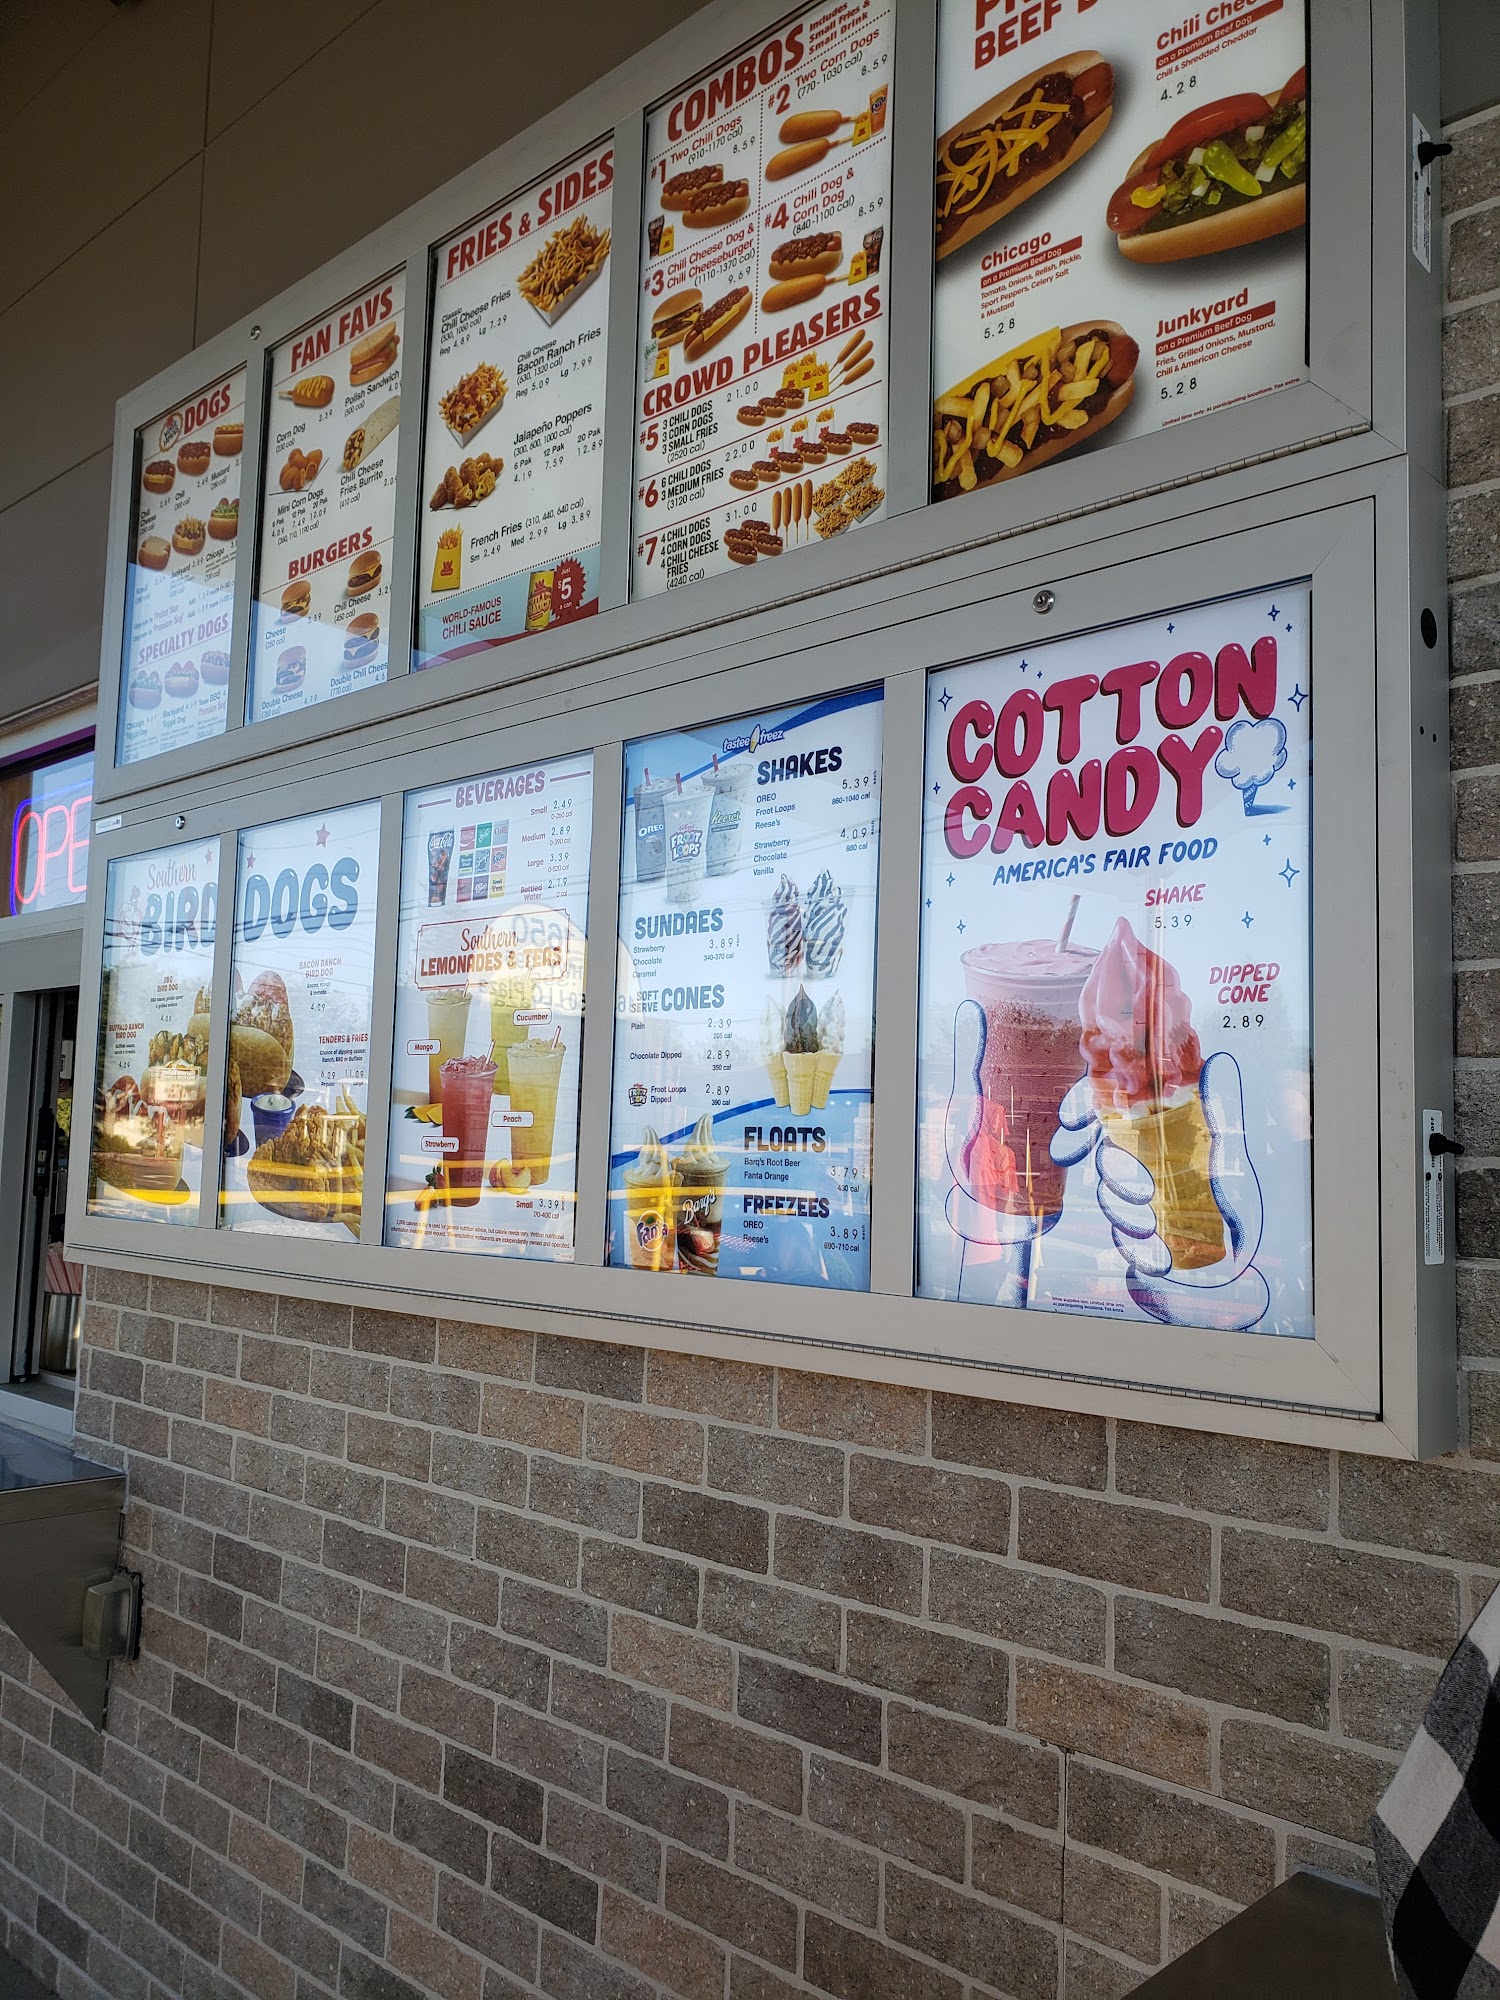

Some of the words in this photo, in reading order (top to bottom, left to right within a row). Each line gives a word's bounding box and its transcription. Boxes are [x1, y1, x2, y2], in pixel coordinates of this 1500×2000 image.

[808, 30, 837, 55] Small
[840, 11, 869, 35] Drink
[974, 2, 1062, 70] BEEF
[1156, 13, 1200, 50] Chili
[1156, 67, 1173, 81] Chili
[1174, 64, 1180, 73] &
[1181, 44, 1220, 70] Shredded
[1221, 26, 1258, 53] Cheddar
[667, 23, 804, 142] COMBOS
[767, 84, 790, 116] #2
[795, 67, 817, 87] Two
[820, 49, 847, 71] Corn
[850, 28, 880, 53] Dogs
[1161, 76, 1197, 102] 4.28
[650, 159, 667, 184] #1
[670, 149, 689, 165] Two
[692, 130, 714, 150] Chili
[716, 115, 742, 136] Dogs
[764, 202, 790, 231] #4
[793, 186, 818, 209] Chili
[821, 177, 843, 197] Dog
[846, 167, 855, 178] &
[447, 212, 512, 281] FRIES
[518, 212, 531, 236] &
[537, 150, 614, 226] SIDES
[644, 269, 665, 296] #3
[667, 257, 687, 275] Chili
[689, 242, 723, 268] Cheese
[726, 228, 745, 246] Dog
[747, 222, 755, 234] &
[667, 272, 686, 290] Chili
[688, 239, 754, 278] Cheeseburger
[980, 232, 1051, 271] Chicago
[980, 283, 1007, 300] Tomato,
[1009, 274, 1034, 291] Onions,
[1035, 262, 1058, 280] Relish,
[1059, 252, 1082, 270] Pickle,
[441, 318, 458, 334] Chili
[460, 304, 489, 325] Cheese
[490, 289, 511, 307] Fries
[1156, 287, 1248, 337] Junkyard
[291, 322, 332, 374] FAN
[338, 285, 393, 346] FAVS
[984, 317, 1016, 339] 5.28
[517, 355, 546, 375] Bacon
[547, 340, 576, 364] Ranch
[578, 327, 601, 348] Fries
[642, 356, 734, 417] CROWD
[743, 285, 882, 375] PLEASERS
[1156, 353, 1177, 369] Fries,
[1178, 343, 1204, 362] Grilled
[1205, 334, 1236, 355] Onions,
[1237, 319, 1276, 340] Mustard,
[1156, 364, 1173, 379] Chili
[1174, 362, 1180, 372] &
[1181, 350, 1220, 371] American
[1221, 338, 1253, 359] Cheese
[344, 389, 366, 407] Polish
[367, 369, 400, 395] Sandwich
[1160, 377, 1197, 400] 5.28
[184, 383, 231, 434] DOGS
[513, 420, 553, 446] Jalapeño
[555, 403, 593, 430] Poppers
[662, 444, 667, 454] 3
[668, 431, 694, 452] SMALL
[695, 422, 718, 440] FRIES
[470, 530, 499, 549] French
[501, 520, 522, 539] Fries
[288, 526, 373, 580] BURGERS
[557, 576, 572, 600] $5
[442, 596, 502, 624] WORLD-FAMOUS
[442, 622, 467, 640] CHILI
[468, 609, 502, 632] SAUCE
[139, 627, 195, 666] SPECIALTY
[197, 612, 229, 641] DOGS
[947, 636, 1277, 785] COTTON
[723, 733, 751, 754] tastee
[759, 728, 785, 744] freez
[756, 745, 843, 786] SHAKES
[455, 770, 546, 809] BEVERAGES
[842, 776, 870, 790] 5.39
[943, 725, 1224, 860] CANDY
[530, 806, 548, 816] Small
[553, 798, 573, 810] 2.49
[755, 805, 773, 817] Froot
[774, 803, 796, 816] Loops
[756, 793, 777, 803] OREO
[521, 832, 546, 843] Medium
[755, 819, 781, 830] Reese's
[840, 827, 867, 840] 4.09
[753, 851, 788, 863] Chocolate
[754, 837, 791, 851] Strawberry
[147, 858, 198, 891] Southern
[527, 858, 544, 869] Large
[752, 865, 775, 876] Vanilla
[992, 853, 1096, 886] AMERICA'S
[1103, 846, 1151, 870] FAIR
[1159, 837, 1218, 866] FOOD
[140, 882, 219, 957] BIRD
[242, 856, 361, 944] DOGS
[1144, 884, 1207, 908] SHAKE
[634, 907, 724, 940] SUNDAES
[1154, 914, 1193, 930] 5.39
[460, 924, 518, 952] Southern
[633, 943, 666, 954] Strawberry
[709, 936, 734, 949] 3.89
[420, 949, 503, 977] LEMONADES
[524, 945, 562, 969] TEAS
[633, 956, 663, 966] Chocolate
[1208, 963, 1281, 986] DIPPED
[630, 1000, 659, 1013] SERVE
[661, 984, 725, 1012] CONES
[637, 990, 659, 1002] SOFT
[1217, 983, 1272, 1006] CONE
[516, 1013, 549, 1022] Cucumber
[707, 1018, 732, 1029] 2.39
[1222, 1014, 1265, 1030] 2.89
[319, 1034, 345, 1044] TENDERS
[346, 1034, 351, 1042] &
[351, 1033, 369, 1043] FRIES
[414, 1043, 434, 1052] Mango
[630, 1051, 660, 1060] Chocolate
[660, 1050, 682, 1061] Dipped
[650, 1085, 666, 1094] Froot
[667, 1085, 687, 1095] Loops
[650, 1095, 672, 1105] Dipped
[503, 1115, 522, 1123] Peach
[424, 1140, 456, 1150] Strawberry
[744, 1126, 826, 1154] FLOATS
[744, 1158, 765, 1168] Barq's
[766, 1158, 783, 1167] Root
[784, 1159, 801, 1168] Beer
[744, 1171, 763, 1180] Fanta
[764, 1171, 789, 1183] Orange
[516, 1200, 533, 1209] Small
[682, 1189, 717, 1225] Barq's
[743, 1194, 830, 1218] FREEZEES
[636, 1219, 669, 1250] Fanta
[743, 1220, 764, 1230] OREO
[830, 1225, 858, 1240] 3.89
